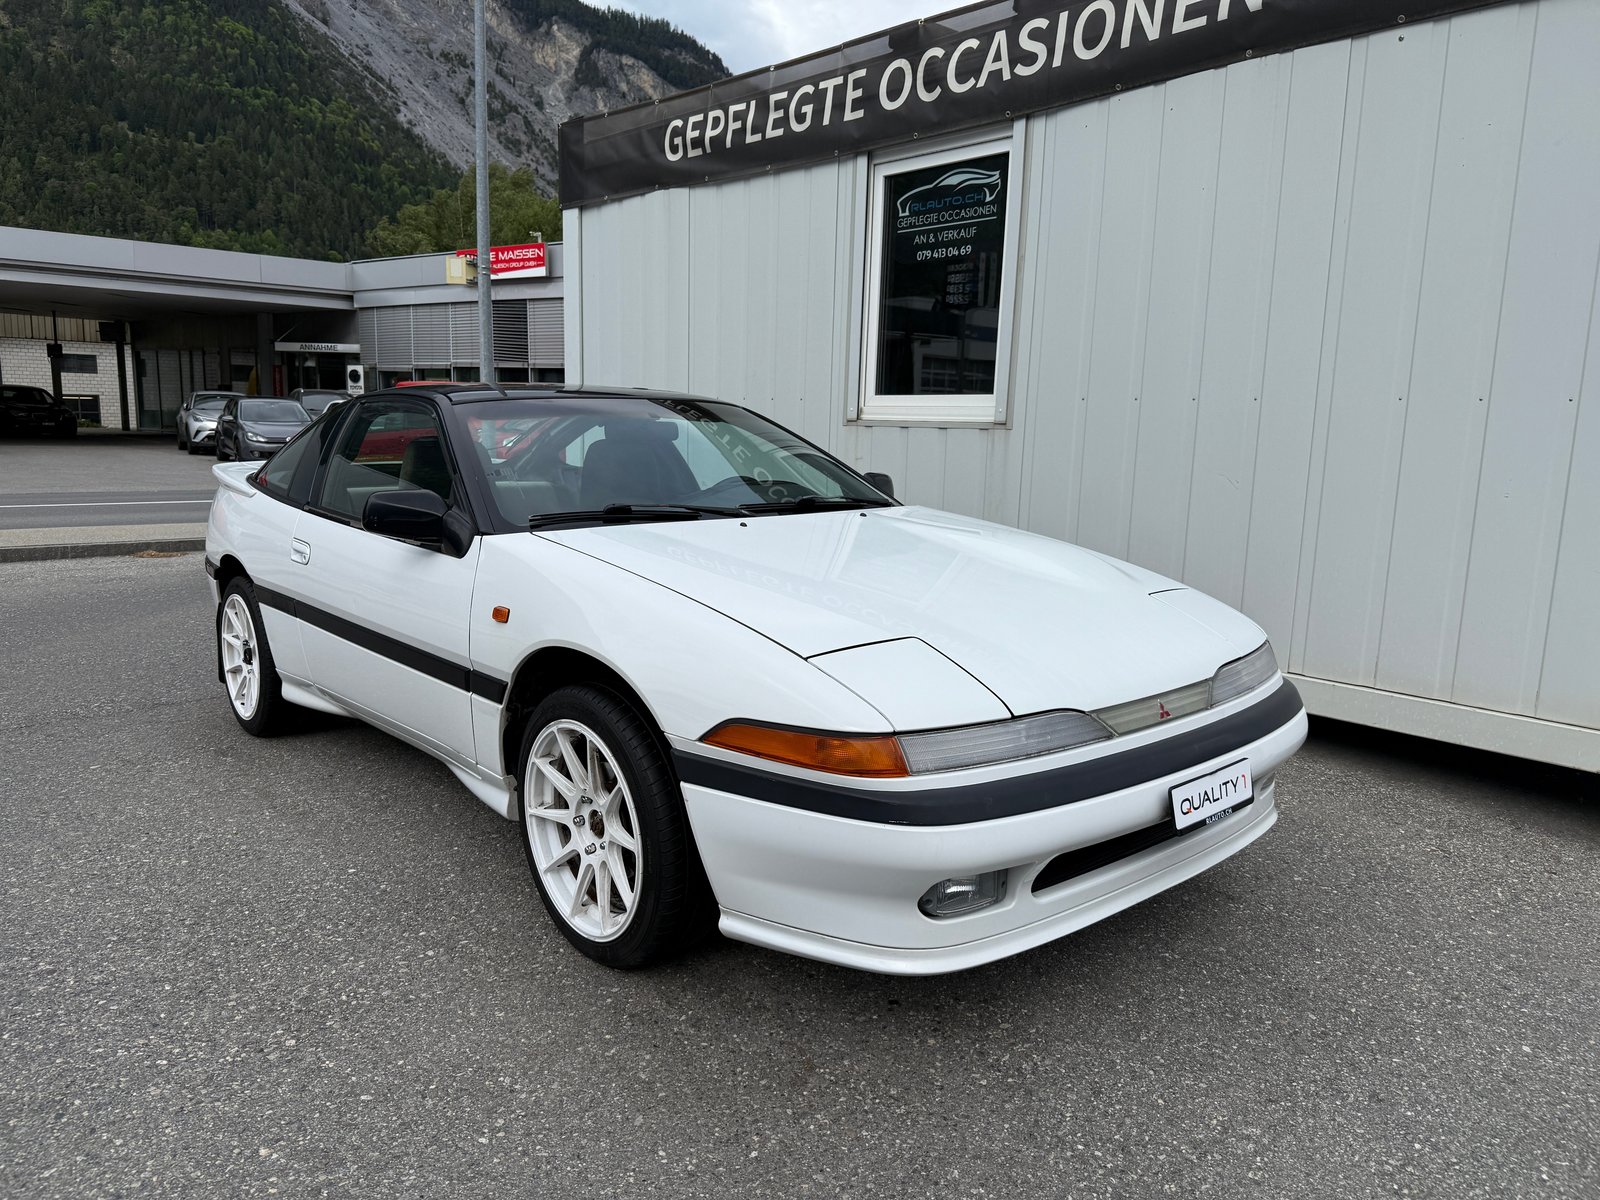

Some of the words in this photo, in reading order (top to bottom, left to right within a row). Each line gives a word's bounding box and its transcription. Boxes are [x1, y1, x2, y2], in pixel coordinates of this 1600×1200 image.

[664, 68, 867, 161] GEPFLEGTE
[910, 192, 984, 212] RLAUTO.CH
[897, 213, 938, 228] GEPFLEGTE
[939, 204, 997, 222] OCCASIONEN
[913, 234, 926, 245] AN
[928, 233, 935, 243] &
[937, 226, 977, 241] VERKAUF
[498, 248, 543, 261] MAISSEN
[916, 249, 932, 261] 079
[932, 248, 946, 259] 413
[947, 246, 959, 257] 04
[960, 244, 972, 255] 69
[299, 344, 339, 352] ANNAHME
[1180, 776, 1239, 816] QUALITY
